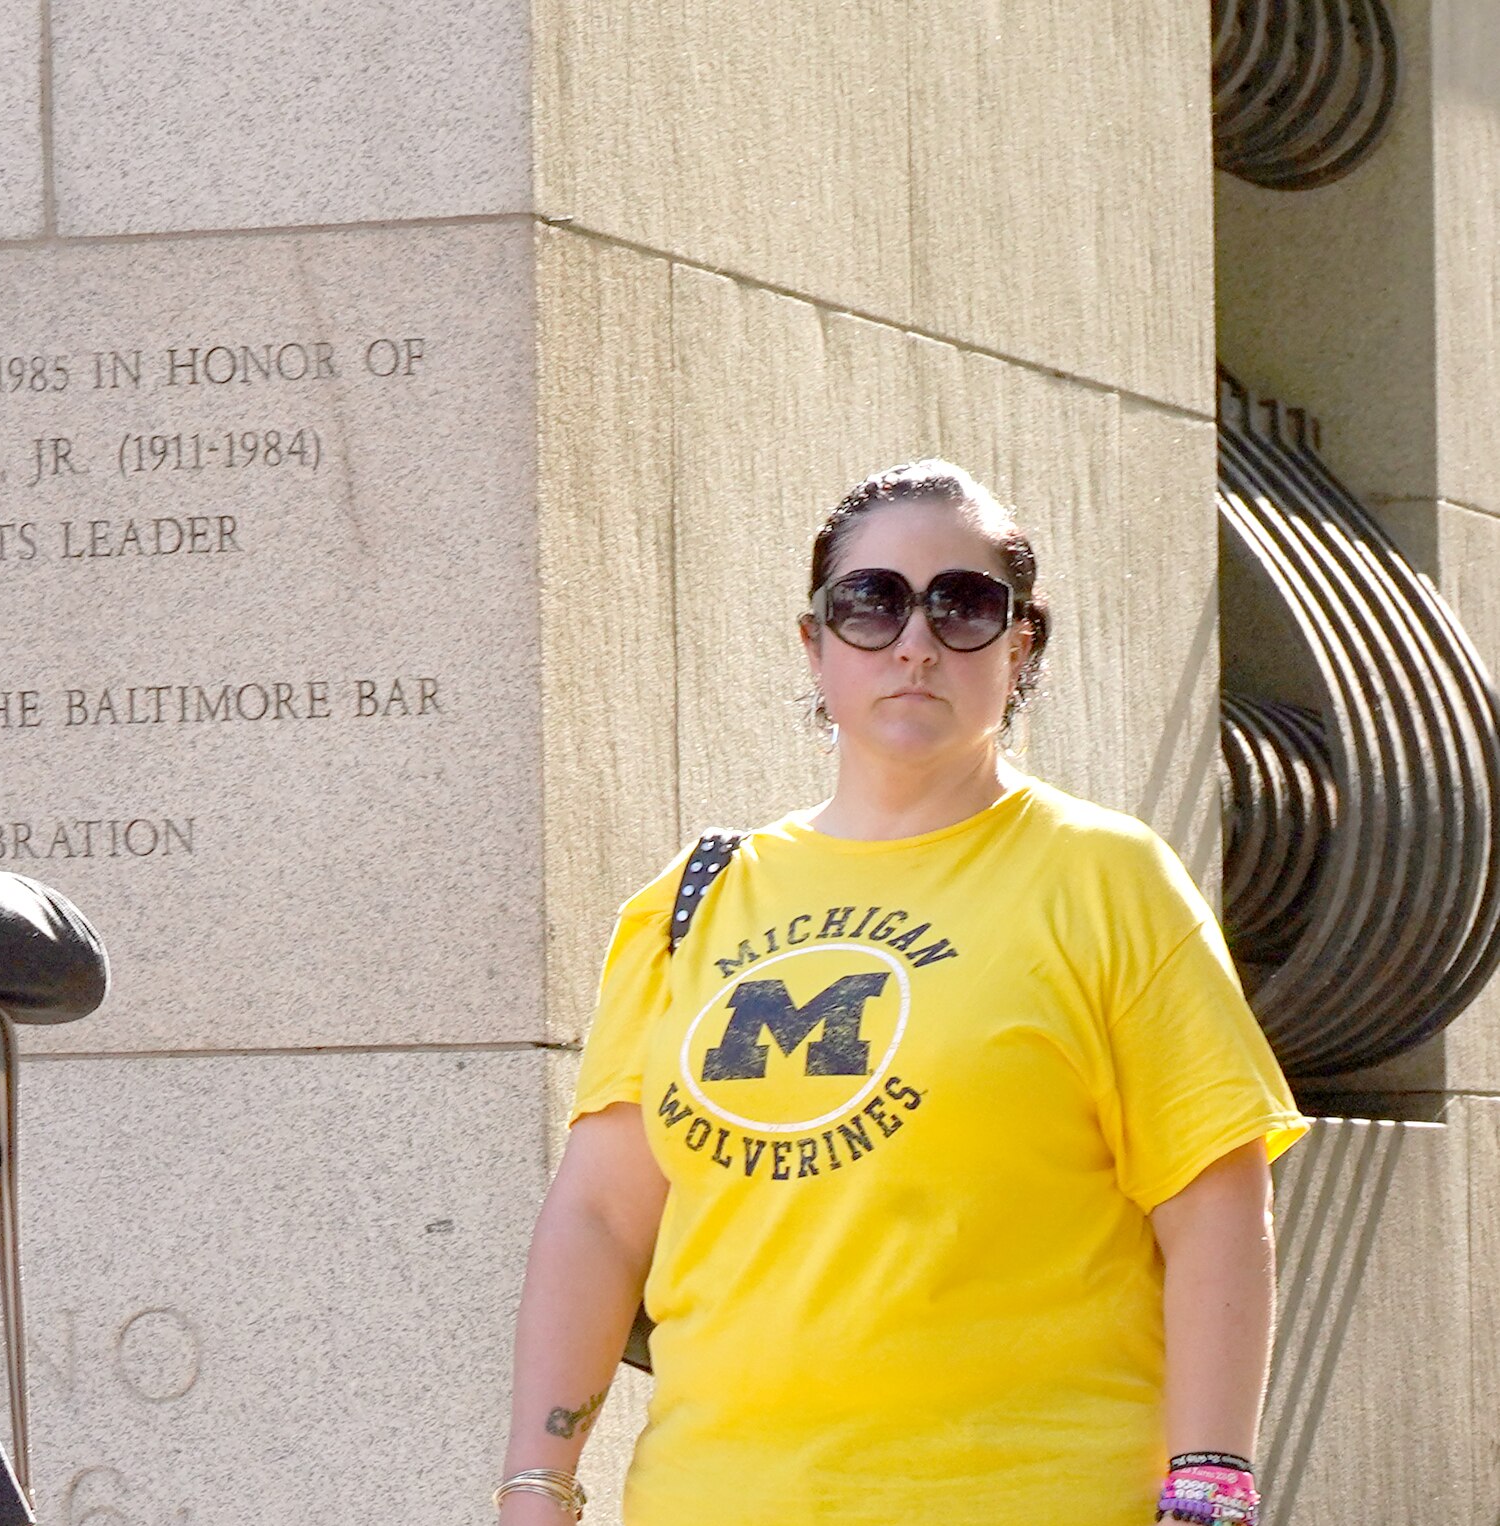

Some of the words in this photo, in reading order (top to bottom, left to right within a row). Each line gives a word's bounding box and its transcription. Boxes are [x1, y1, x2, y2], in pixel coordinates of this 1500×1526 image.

[91, 350, 144, 391] IN
[166, 341, 343, 387] HONOR
[365, 337, 427, 378] OF
[116, 427, 323, 480] (1911-1984)
[60, 514, 245, 560] LEADER
[64, 681, 331, 727] BALTIMORE
[353, 677, 449, 718] BAR
[713, 905, 960, 980] MICHIGAN
[700, 971, 892, 1083] M
[657, 1075, 929, 1181] WOLVERINES
